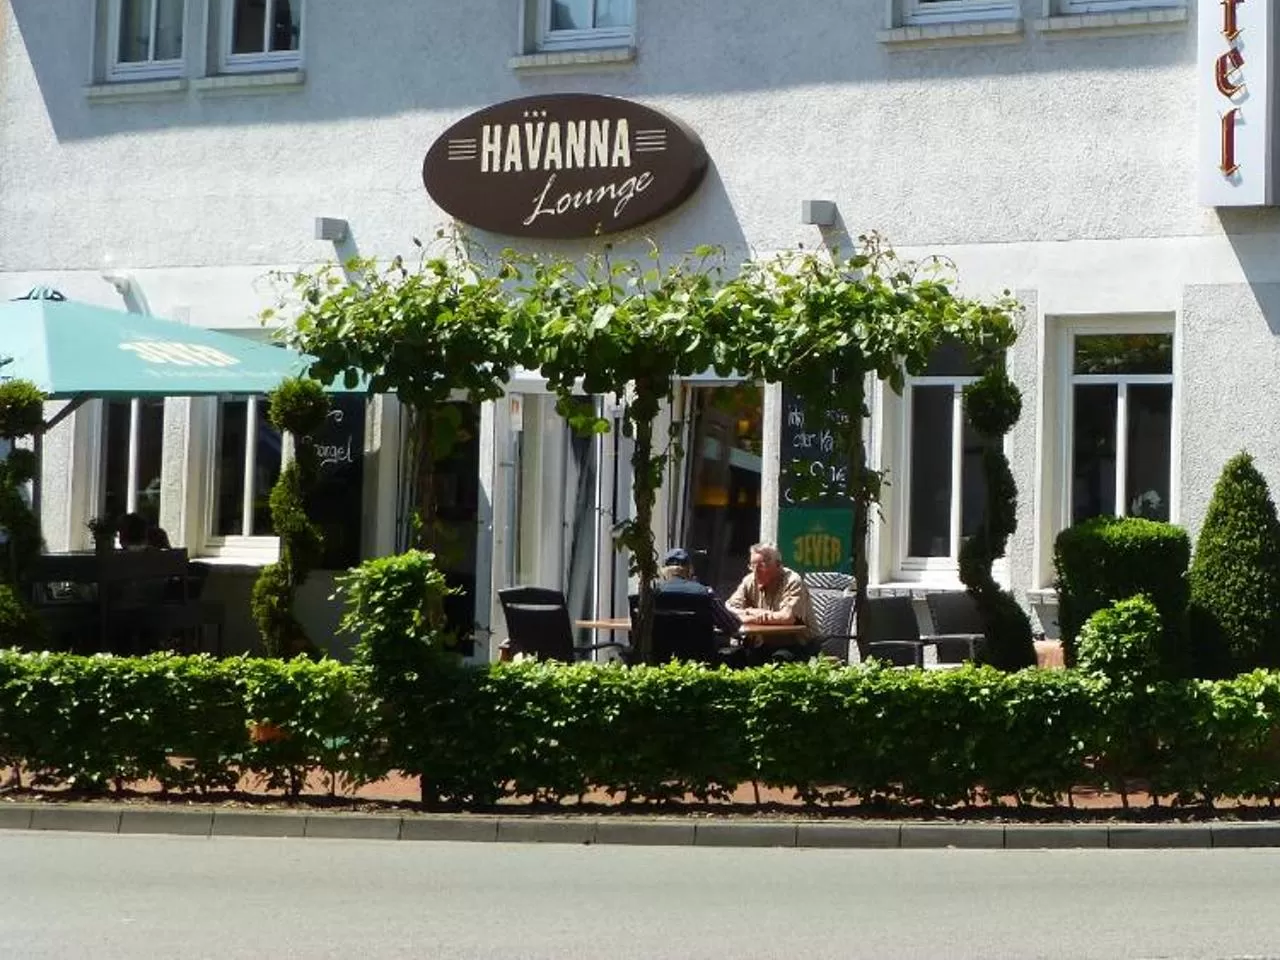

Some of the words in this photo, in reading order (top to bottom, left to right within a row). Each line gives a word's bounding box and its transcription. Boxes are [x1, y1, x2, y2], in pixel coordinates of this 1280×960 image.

[480, 115, 631, 173] HAVANNA
[523, 170, 655, 226] Lounge
[791, 532, 842, 567] JEVER
